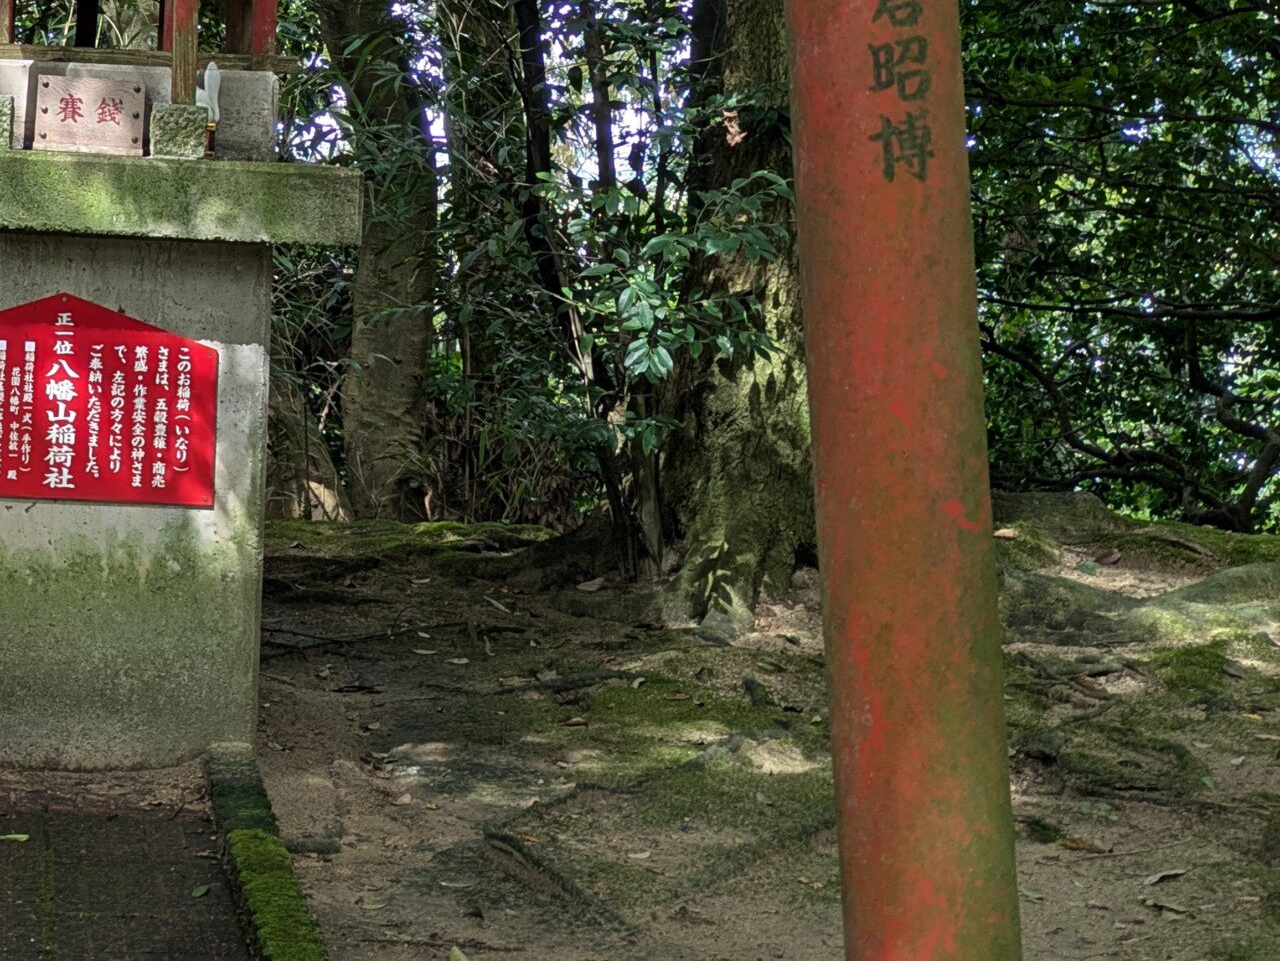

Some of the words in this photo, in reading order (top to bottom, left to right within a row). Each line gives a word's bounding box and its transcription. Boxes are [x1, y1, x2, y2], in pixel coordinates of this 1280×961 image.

[53, 312, 74, 355] 正一位
[42, 359, 80, 489] 八幡山稲荷社
[85, 344, 105, 478] ご奉納いただきました。
